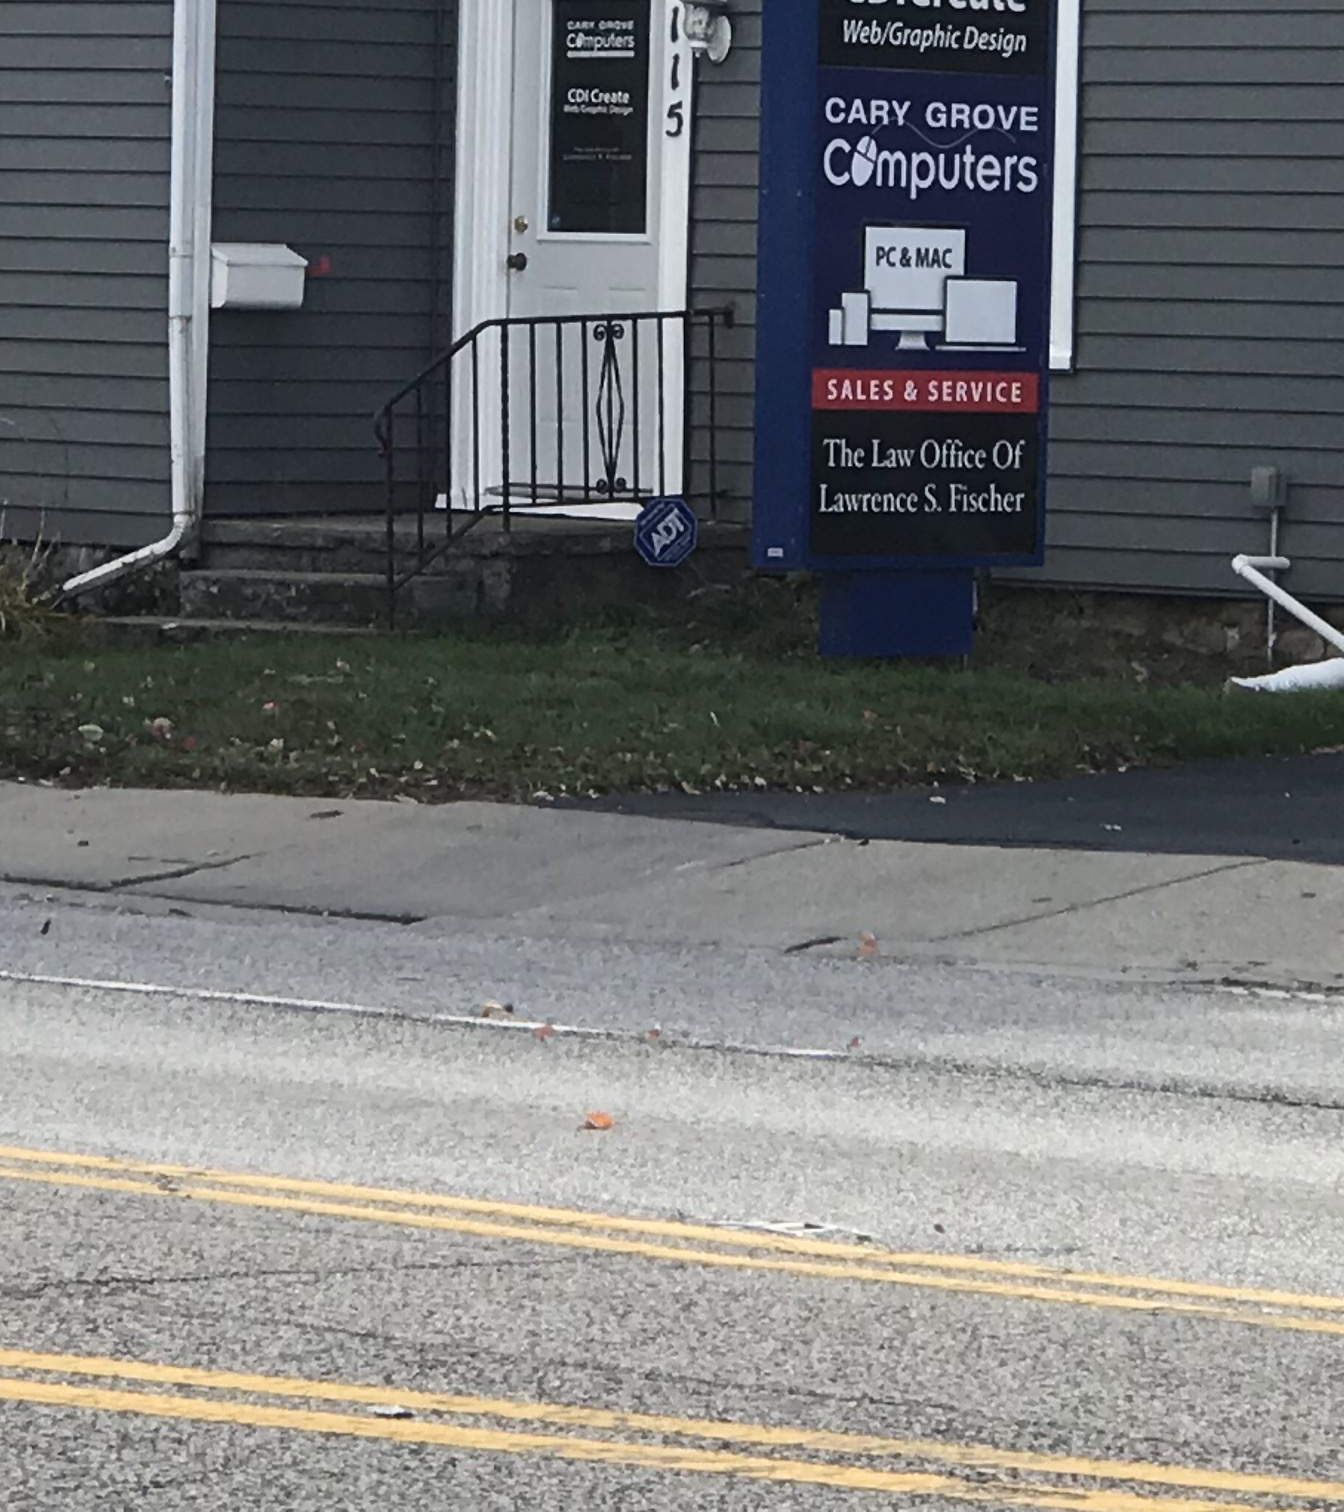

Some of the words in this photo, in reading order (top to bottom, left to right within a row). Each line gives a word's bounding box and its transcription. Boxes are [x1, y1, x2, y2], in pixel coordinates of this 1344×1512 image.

[842, 19, 961, 53] Web/Graphic
[963, 26, 1027, 57] Design
[824, 97, 911, 126] CARY
[925, 102, 1039, 131] GROVE
[875, 246, 897, 267] PC
[899, 246, 912, 268] &
[914, 247, 953, 269] MAC
[826, 378, 894, 401] SALES
[903, 380, 918, 401] &
[927, 380, 1022, 403] SERVICE
[823, 438, 865, 469] The
[870, 439, 915, 469] Law
[920, 439, 987, 469] Office
[992, 439, 1026, 470] Of
[818, 483, 919, 513] Lawrence
[924, 483, 943, 513] S.
[949, 483, 1025, 513] Fischer
[651, 508, 685, 557] ADT
